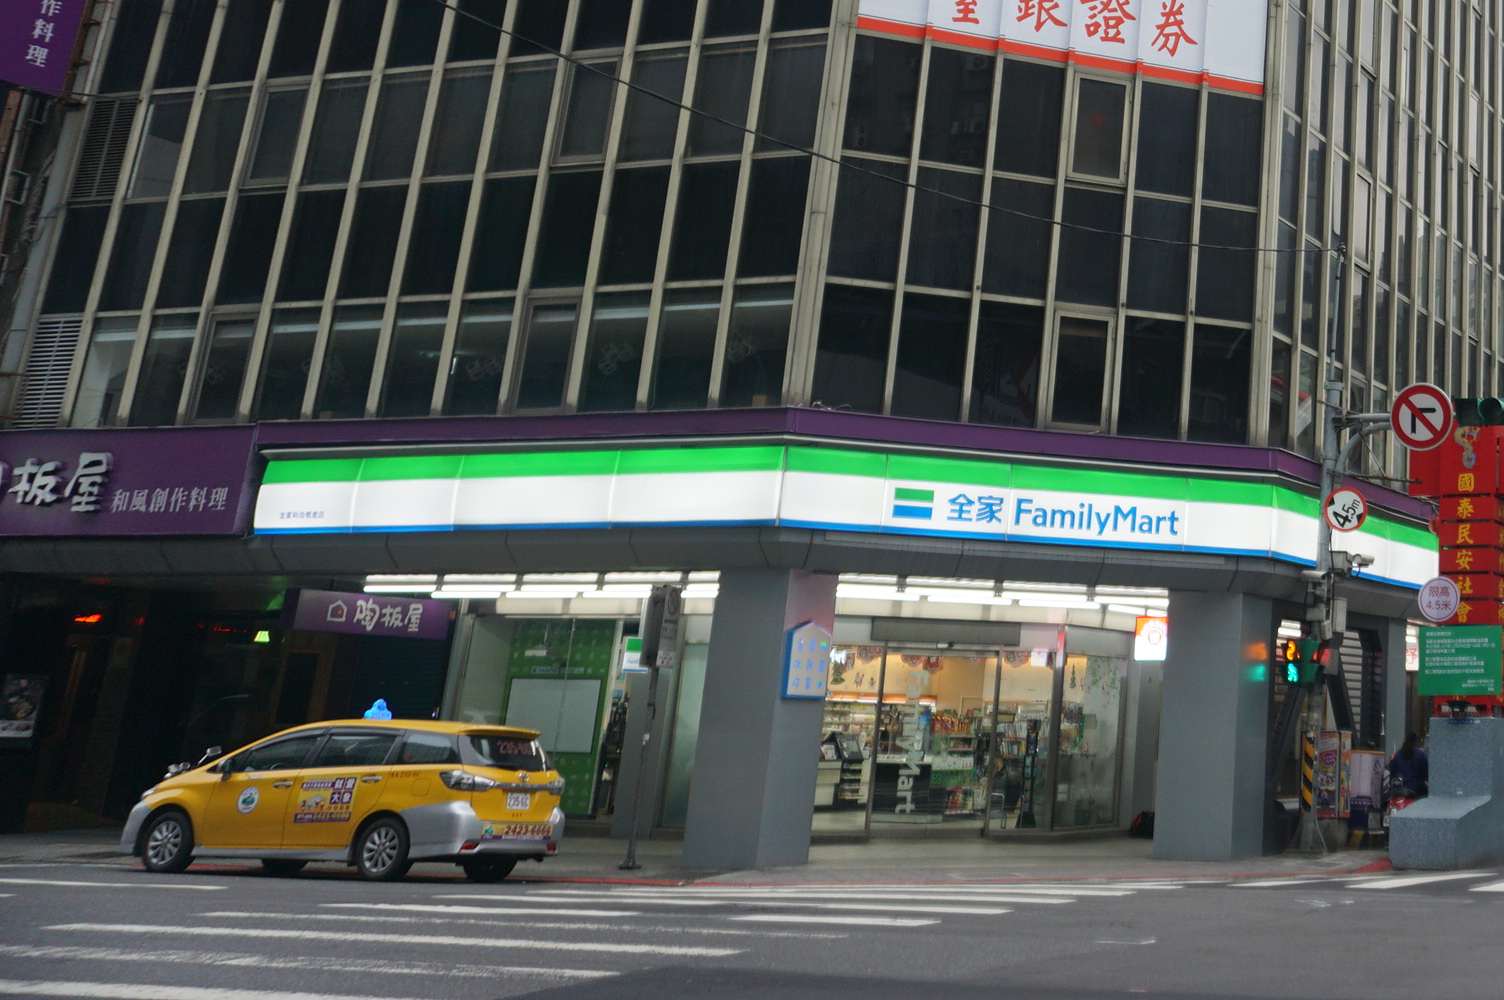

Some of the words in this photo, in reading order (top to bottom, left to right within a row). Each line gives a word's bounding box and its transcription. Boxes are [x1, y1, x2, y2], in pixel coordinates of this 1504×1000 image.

[0, 452, 113, 513] 板屋
[110, 487, 229, 513] 和風創作料理
[946, 493, 1004, 524] 全家
[1014, 497, 1179, 536] FamilyMart
[1332, 499, 1361, 529] 4.5m
[1426, 600, 1451, 611] 4.5米
[1428, 585, 1450, 598] 限高
[353, 598, 424, 633] 陶板屋
[895, 670, 930, 814] FamilyMart
[504, 825, 551, 836] 2423-6666
